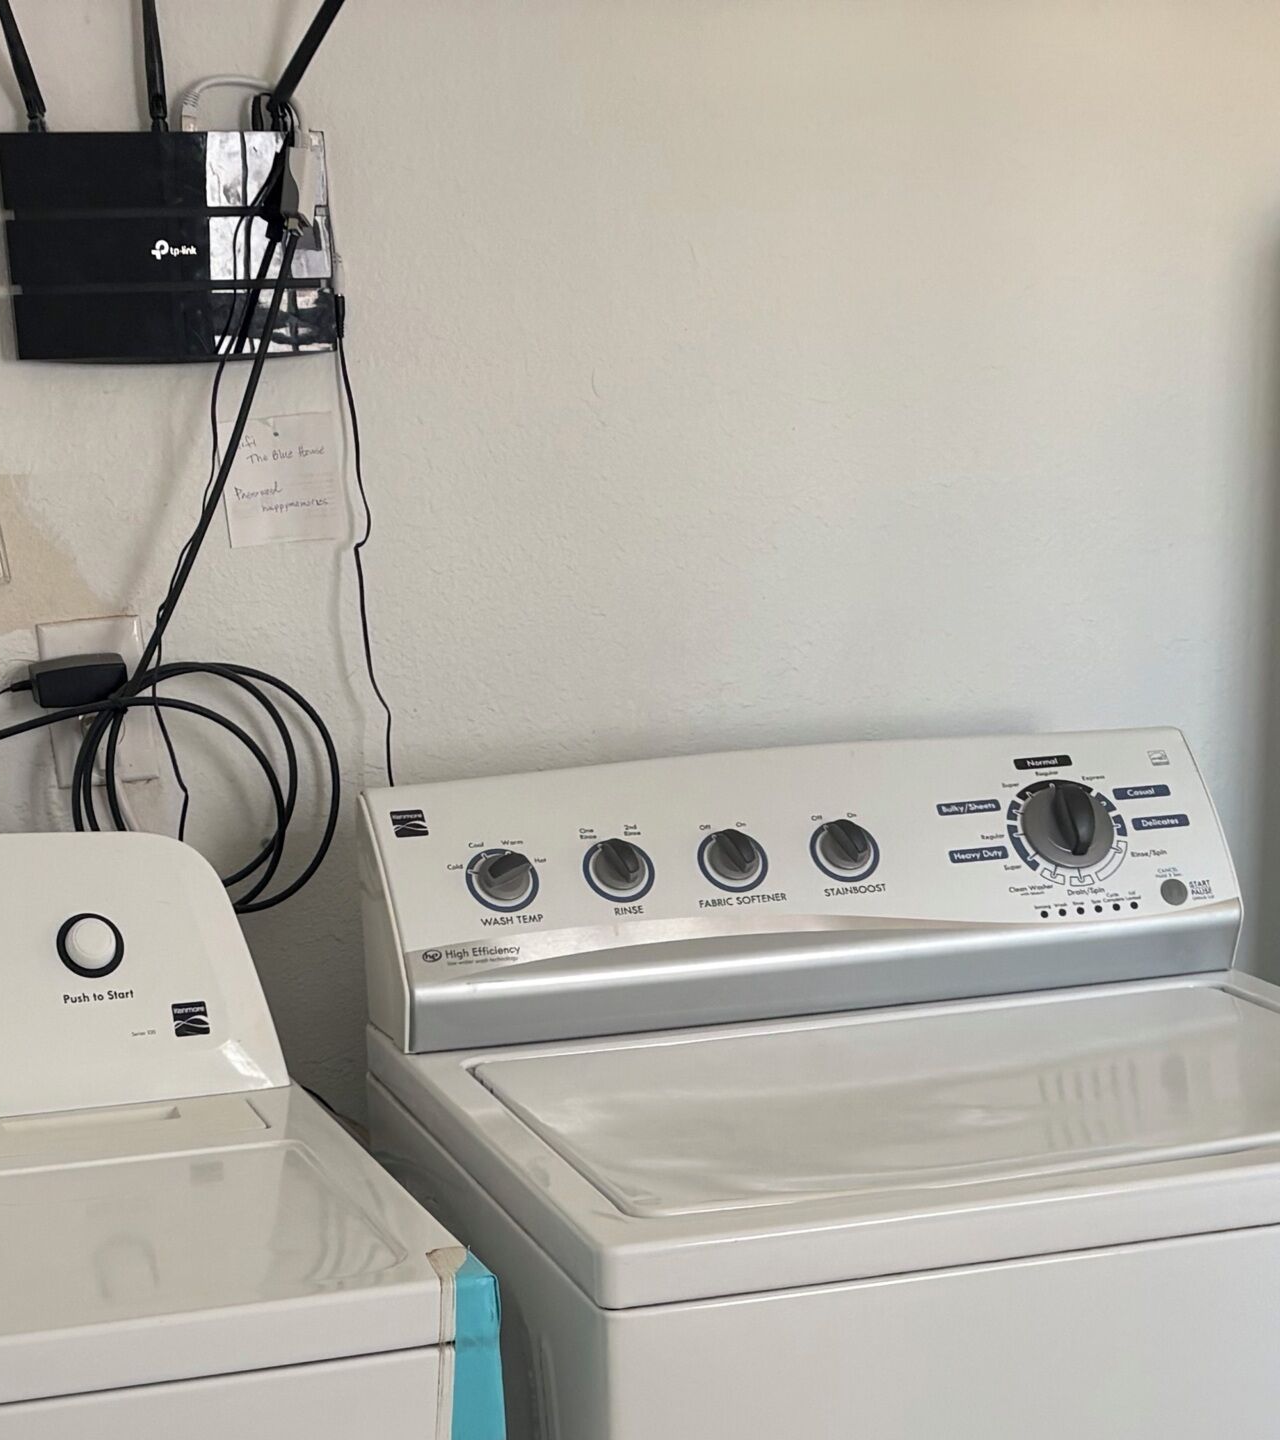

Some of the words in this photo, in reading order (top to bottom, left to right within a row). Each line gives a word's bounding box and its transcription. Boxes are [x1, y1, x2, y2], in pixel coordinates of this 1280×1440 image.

[272, 448, 294, 462] Blue
[1026, 758, 1058, 768] Normal
[1126, 787, 1156, 797] Casual
[941, 802, 997, 814] Bulky/Sheets
[1141, 817, 1180, 828] Delicates
[468, 841, 485, 849] Cool
[501, 839, 524, 847] Warm
[953, 851, 981, 861] Heavy
[982, 849, 1004, 859] Duty
[1130, 849, 1168, 859] Rinse/Spin
[446, 862, 464, 871] Cold
[1189, 879, 1211, 888] START
[823, 883, 887, 898] STAINBOOST
[1067, 887, 1106, 897] Drain/Spin
[1191, 887, 1212, 896] PAUSE
[698, 897, 734, 909] FABRIC
[735, 892, 788, 906] SOFTENER
[614, 904, 645, 916] RINSE
[480, 916, 515, 927] WASH
[516, 914, 544, 925] TEMP
[445, 948, 470, 960] High
[471, 946, 521, 958] Efficiency
[62, 992, 90, 1004] Push
[93, 993, 105, 1001] to
[106, 989, 134, 1001] Start
